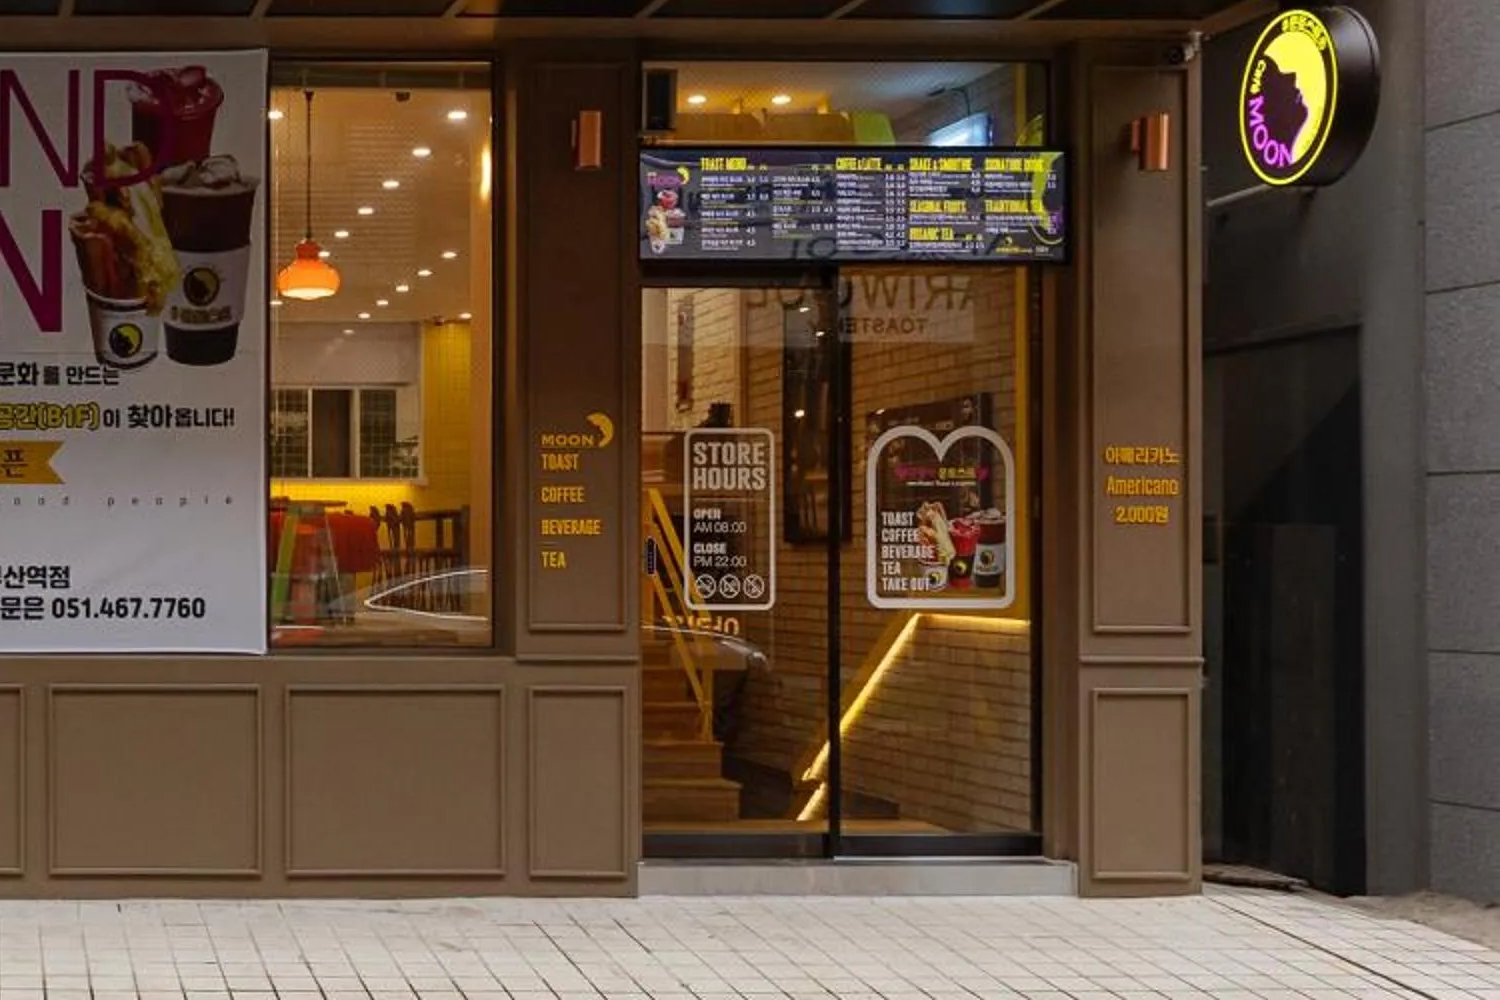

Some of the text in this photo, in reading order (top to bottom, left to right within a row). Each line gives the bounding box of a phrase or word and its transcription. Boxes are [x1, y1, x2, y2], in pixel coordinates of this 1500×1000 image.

[1249, 96, 1293, 167] MOON
[66, 363, 120, 386] 만드는
[541, 434, 594, 446] MOON
[693, 441, 765, 465] STORE
[541, 453, 579, 470] TOAST
[693, 467, 766, 490] HOURS
[1107, 476, 1179, 495] Americano
[541, 485, 585, 503] COFFEE
[693, 507, 721, 520] OPEN
[882, 511, 915, 526] TOAST
[541, 519, 600, 535] BEVERAGE
[693, 522, 712, 533] AM
[882, 528, 920, 542] COFFEE
[693, 542, 727, 554] CLOSE
[882, 545, 935, 559] BEVERAGE
[541, 551, 566, 568] TEA
[693, 555, 747, 567] PM 22:00
[882, 562, 900, 576] TEA
[882, 577, 930, 591] TAKE OUT
[51, 597, 206, 619] 051.467.7760
